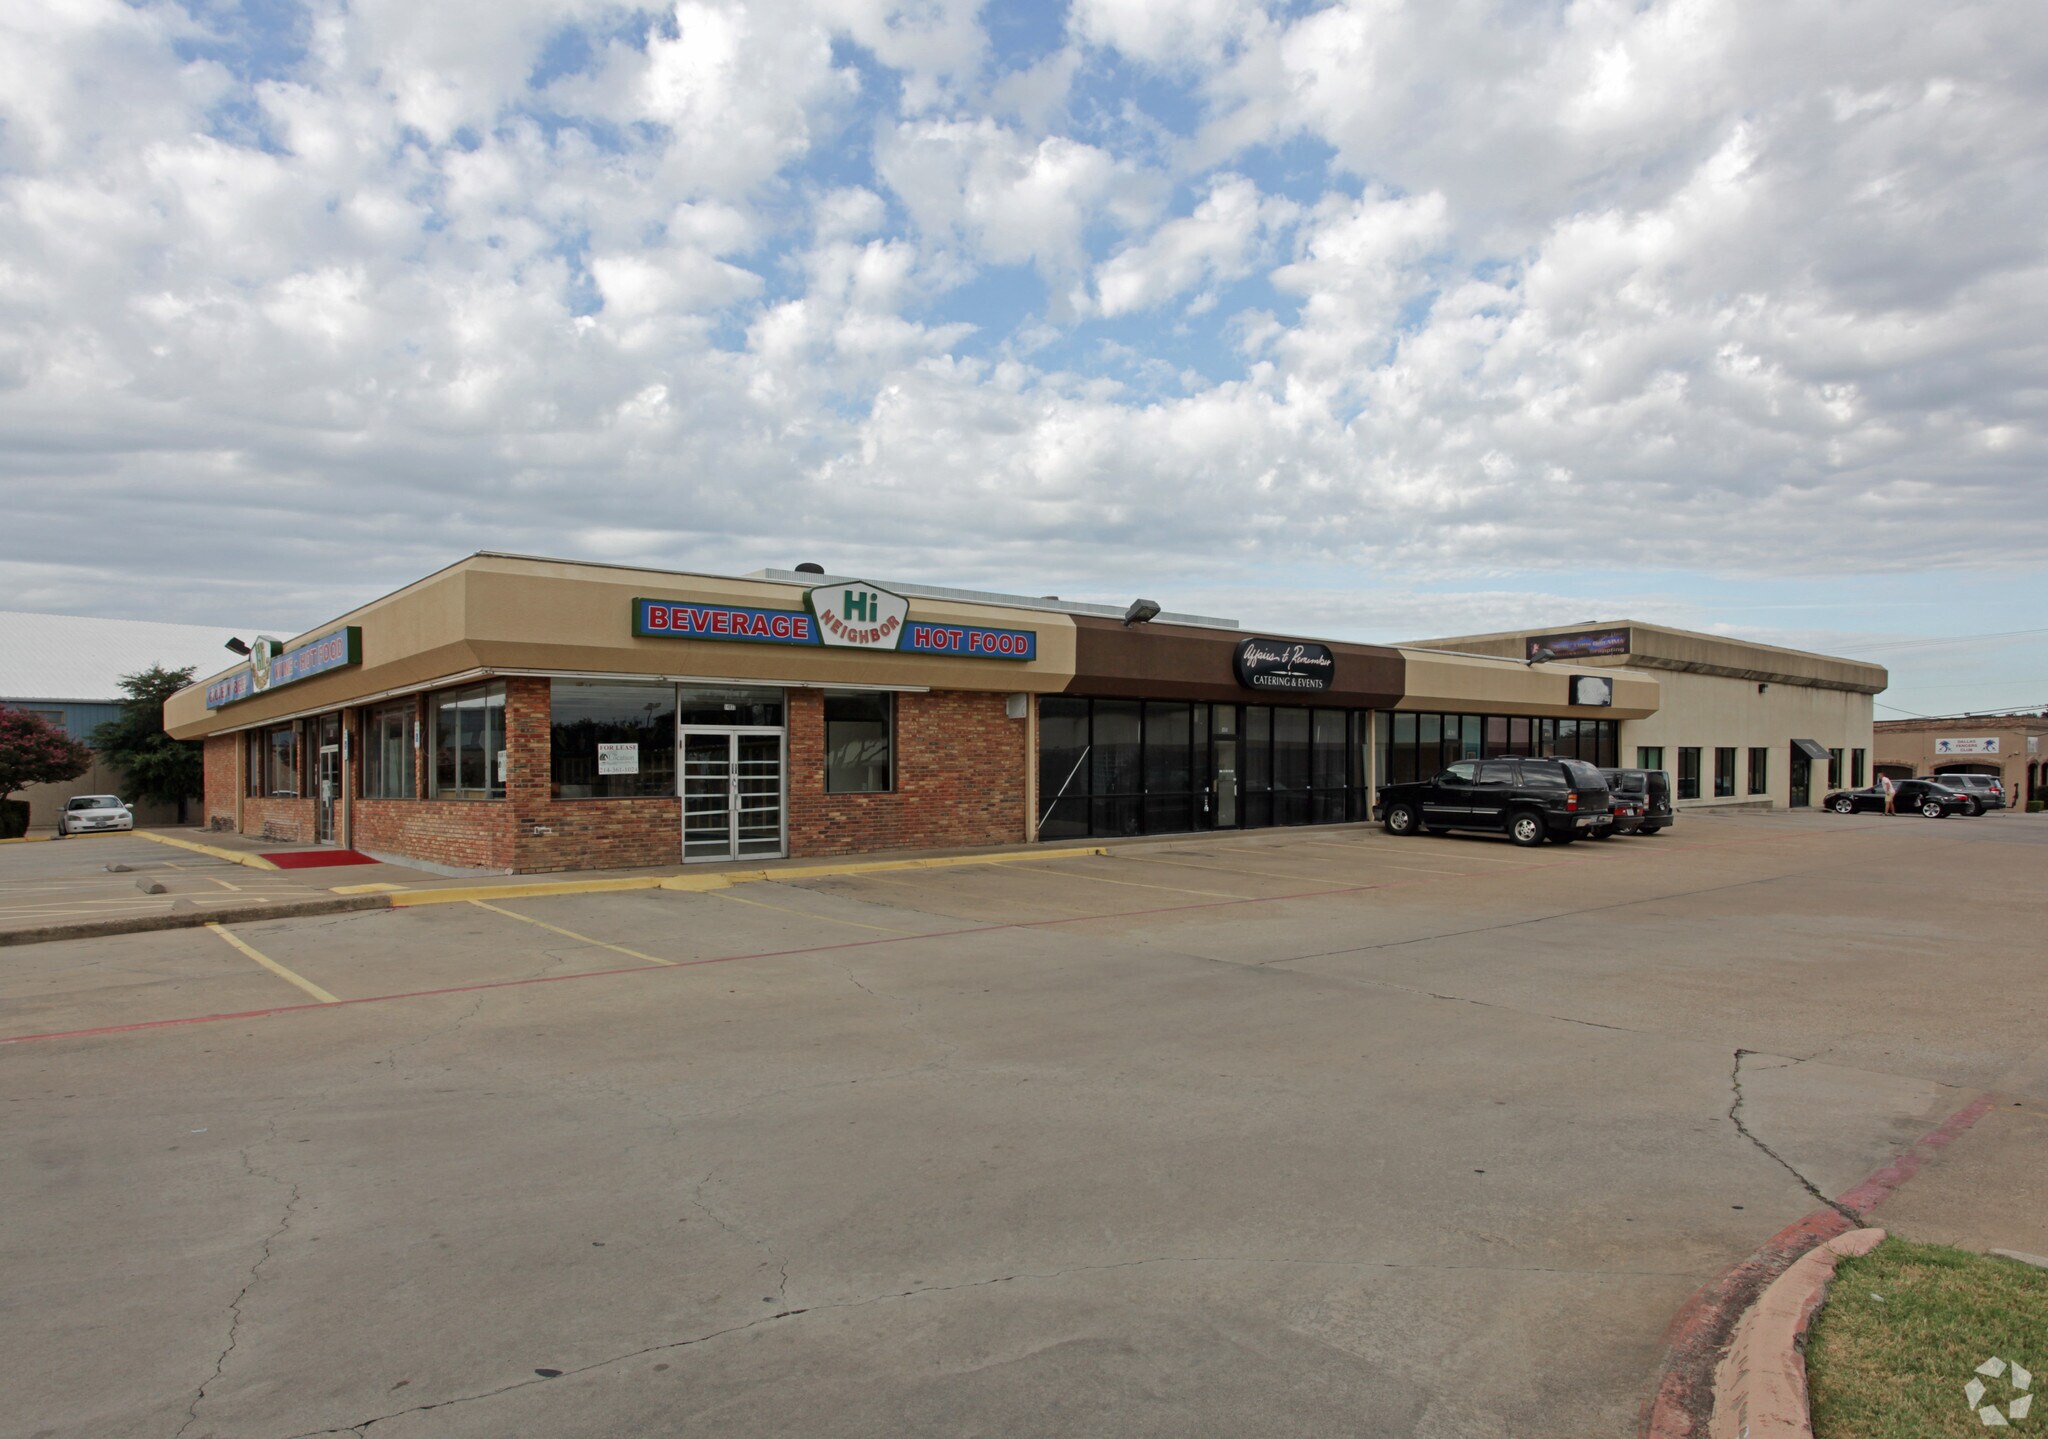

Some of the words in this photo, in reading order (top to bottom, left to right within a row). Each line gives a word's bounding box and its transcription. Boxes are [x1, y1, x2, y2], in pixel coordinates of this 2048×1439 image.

[844, 590, 878, 622] Hi
[647, 605, 809, 640] BEVERAGE
[820, 608, 900, 644] NEIGHBOR
[318, 637, 343, 664] FOOD
[914, 626, 964, 650] HOT
[968, 631, 1029, 655] FOOD
[1253, 675, 1291, 687] CATERING
[1297, 678, 1323, 689] EVENTS
